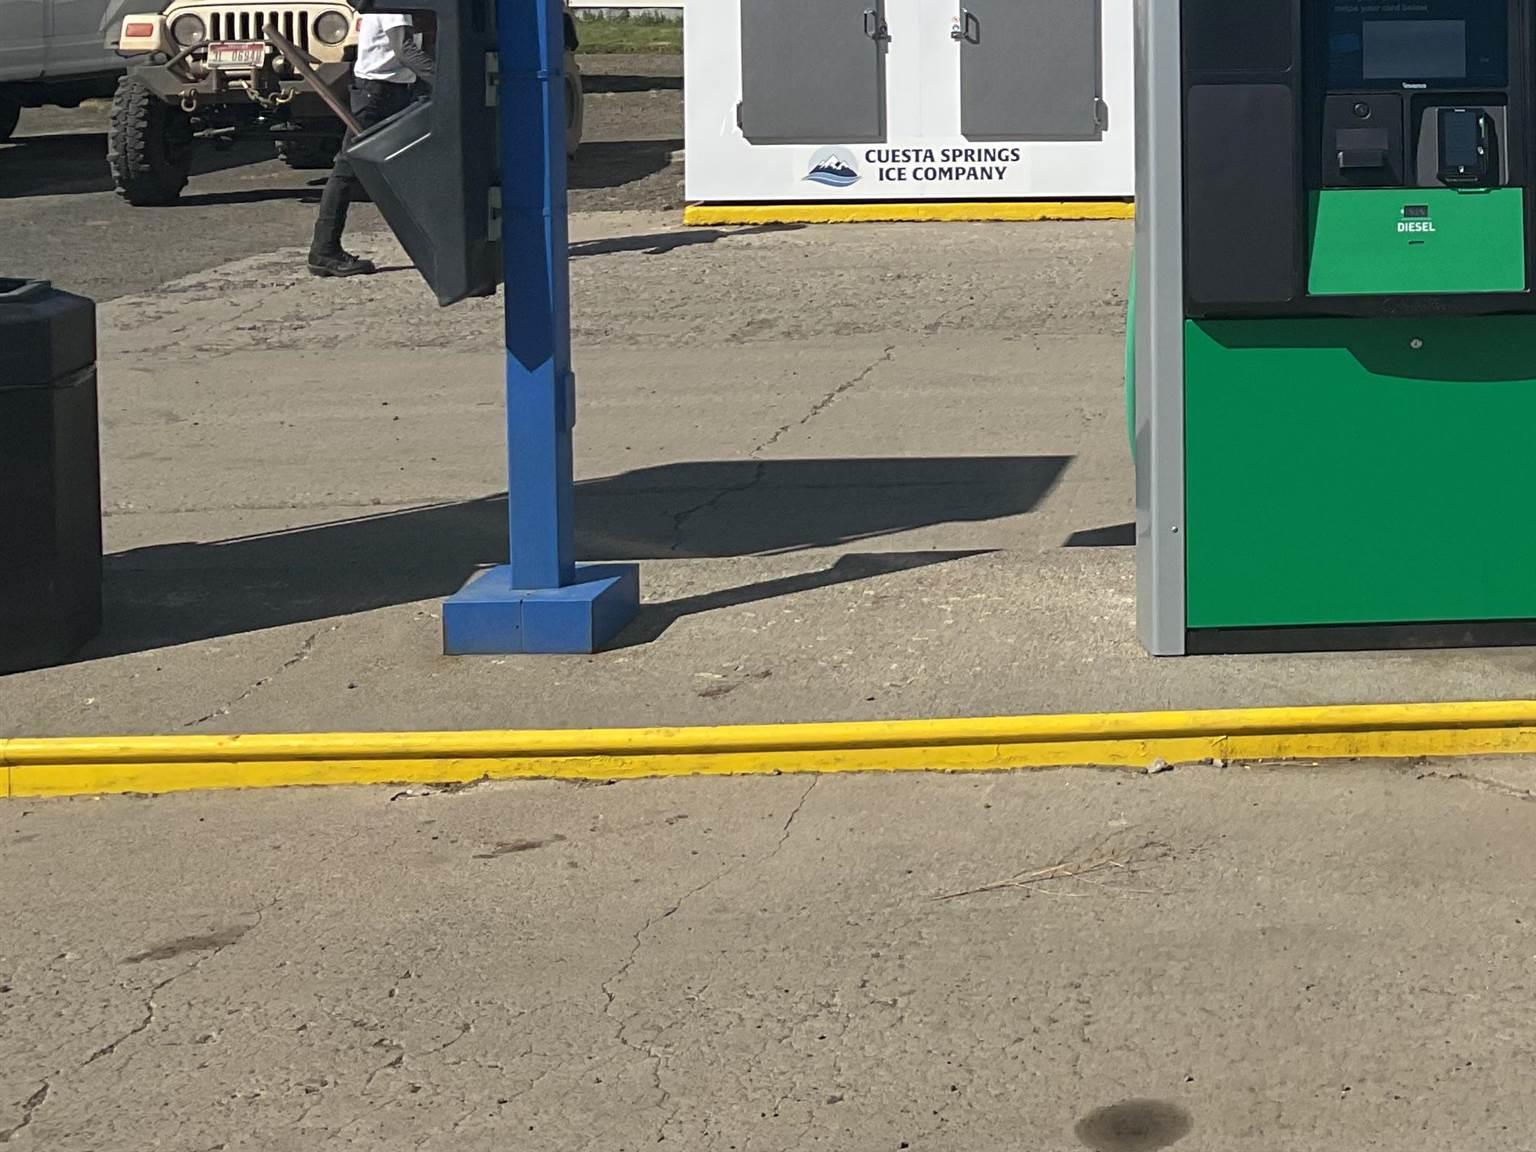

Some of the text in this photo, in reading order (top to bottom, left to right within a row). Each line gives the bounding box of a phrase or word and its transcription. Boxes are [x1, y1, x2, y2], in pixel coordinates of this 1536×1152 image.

[865, 148, 1022, 165] CUESTA SPRINGS
[878, 165, 1008, 182] ICE COMPANY
[1397, 222, 1436, 232] DIESEL
